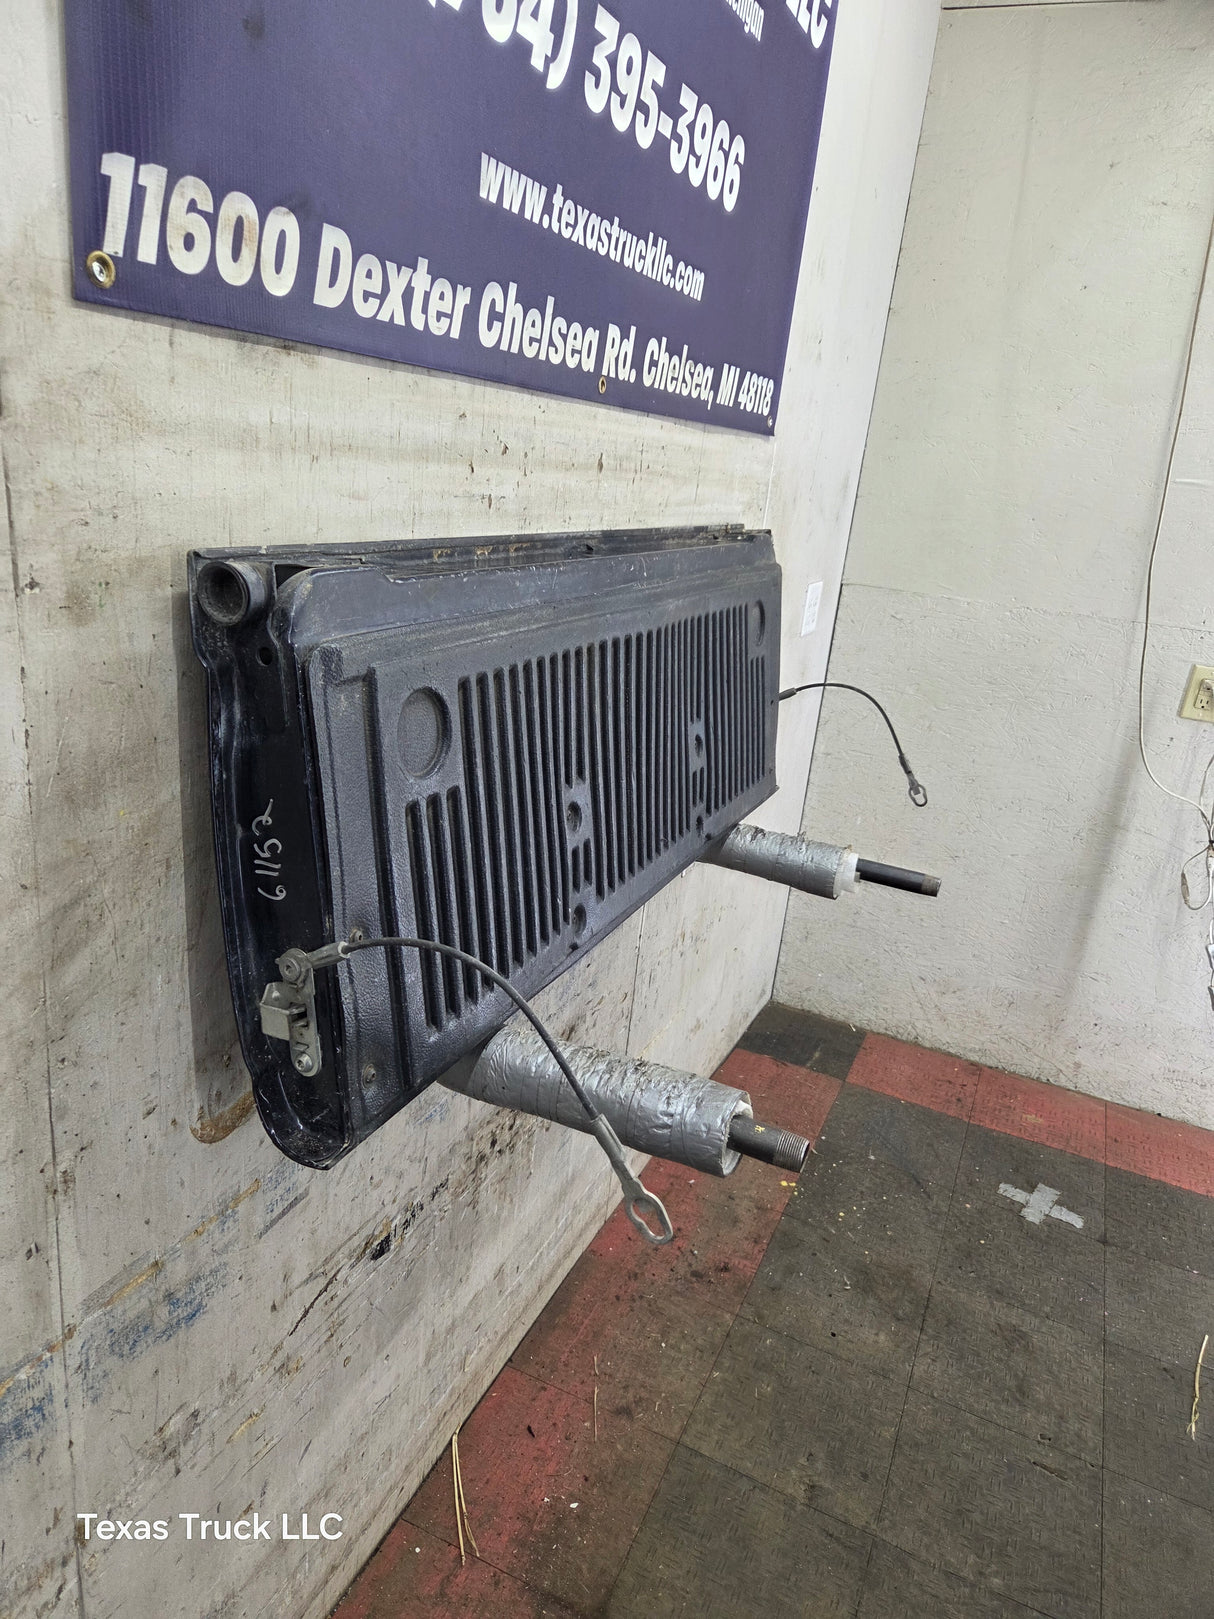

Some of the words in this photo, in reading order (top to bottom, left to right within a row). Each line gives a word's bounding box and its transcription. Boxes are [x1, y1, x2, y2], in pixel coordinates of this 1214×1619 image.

[584, 4, 746, 212] 395-3966
[100, 152, 300, 297] 11600
[313, 223, 472, 340] Dexter
[478, 281, 600, 373] Chelsea
[602, 323, 637, 384] Rd.
[643, 337, 715, 410] Chelsea,
[716, 363, 740, 407] MI
[738, 371, 774, 416] 48118
[479, 152, 705, 301] www.texastruckllc.com
